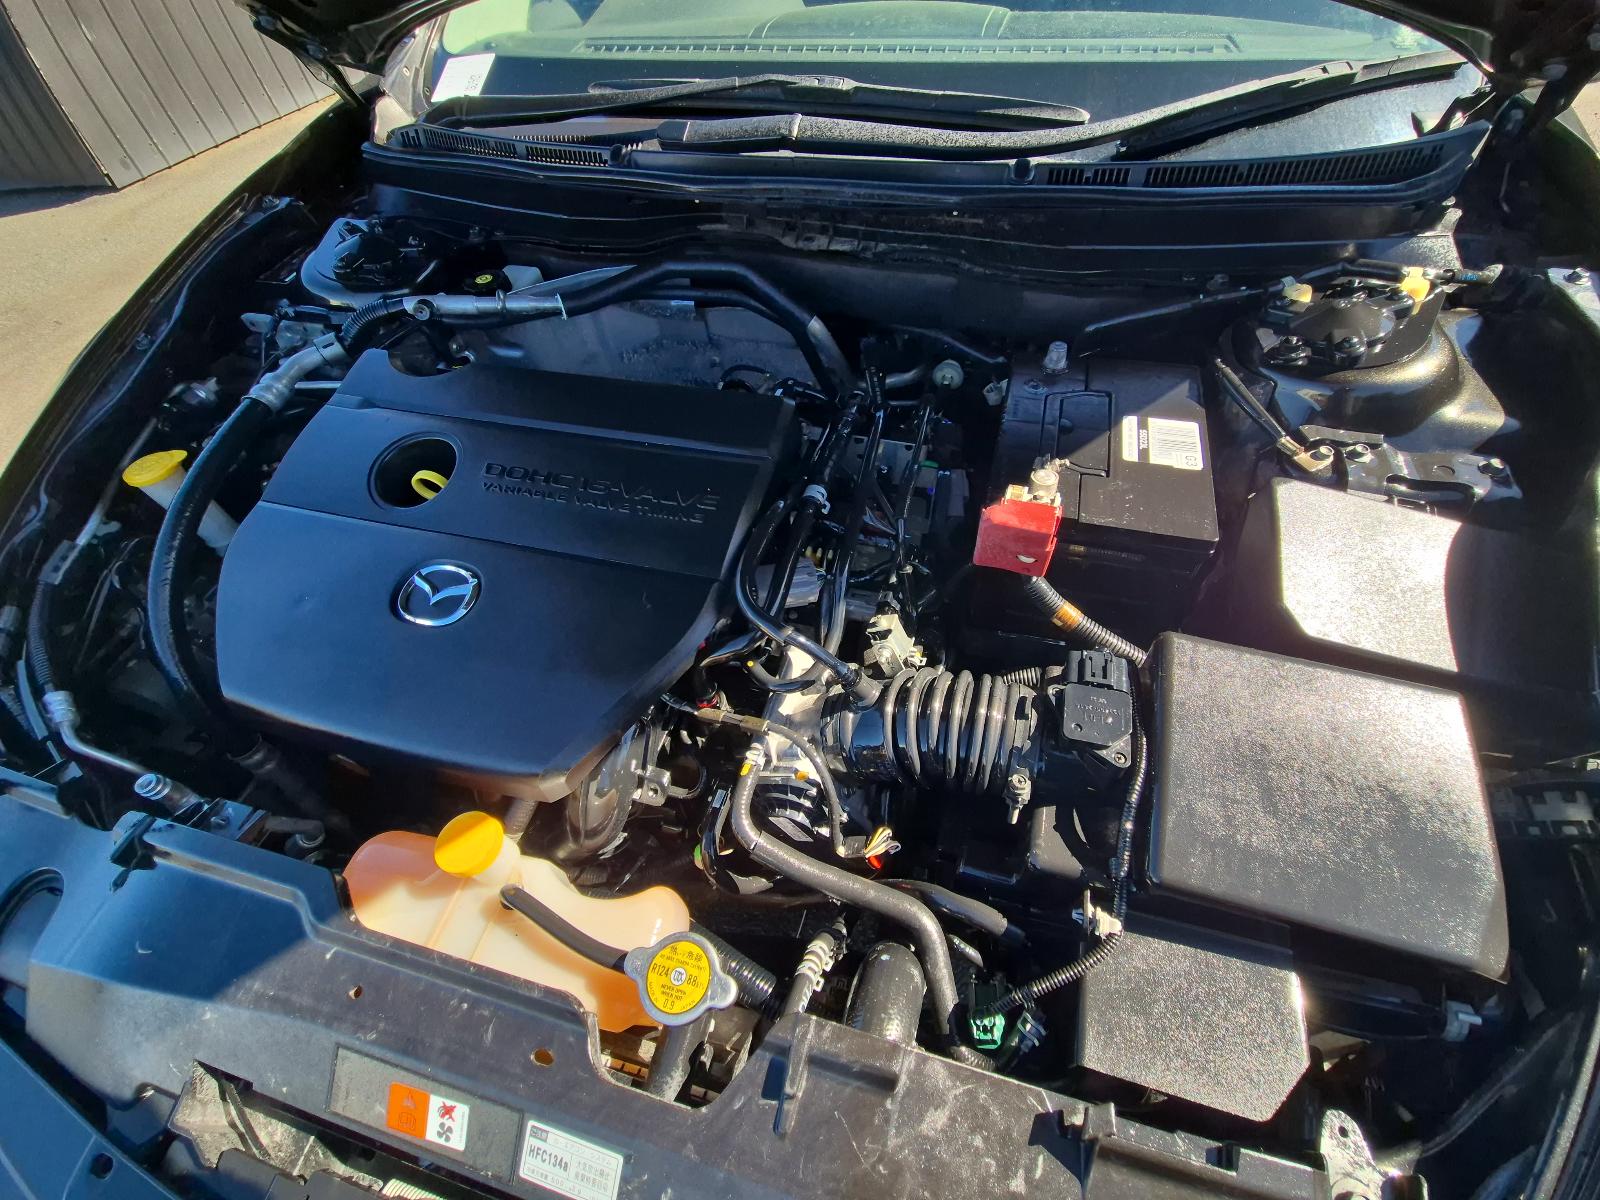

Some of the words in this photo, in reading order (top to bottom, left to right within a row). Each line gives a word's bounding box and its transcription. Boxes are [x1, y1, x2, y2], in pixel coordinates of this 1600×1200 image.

[481, 481, 568, 504] VARIABLE
[483, 462, 575, 489] DOHC
[578, 476, 721, 511] 16-VALVE
[651, 962, 670, 978] R124
[528, 1144, 569, 1172] HFC134a
